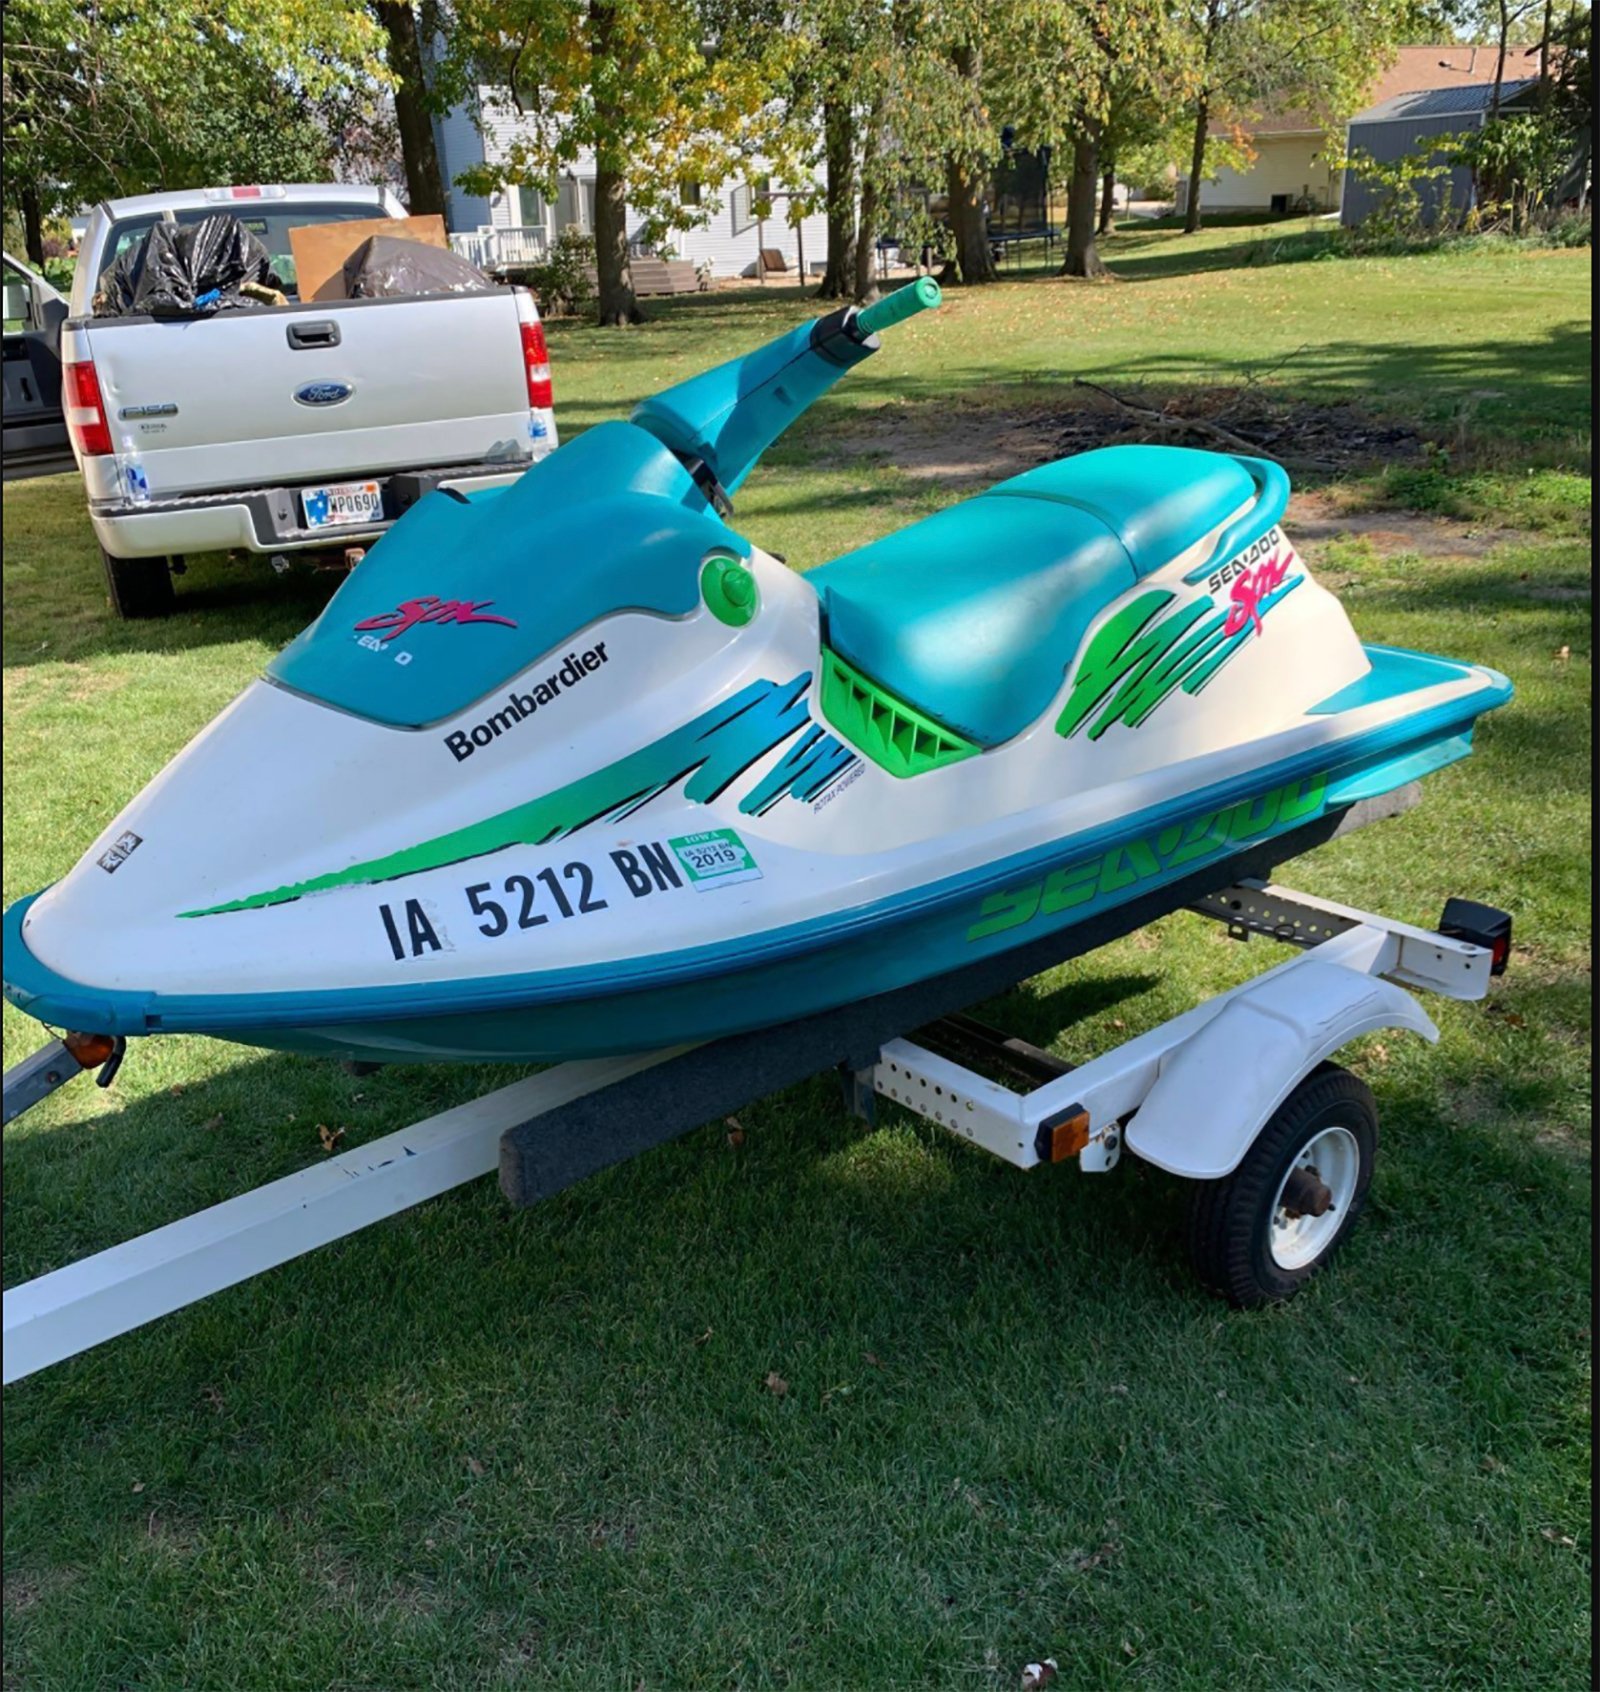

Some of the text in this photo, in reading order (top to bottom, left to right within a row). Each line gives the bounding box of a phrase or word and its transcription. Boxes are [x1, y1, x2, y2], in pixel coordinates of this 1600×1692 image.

[443, 641, 610, 762] Bombardier
[813, 763, 866, 815] ROTAX POWERED
[684, 831, 720, 844] IOWA
[691, 849, 736, 869] 2019
[379, 841, 684, 961] IA 5212 BN
